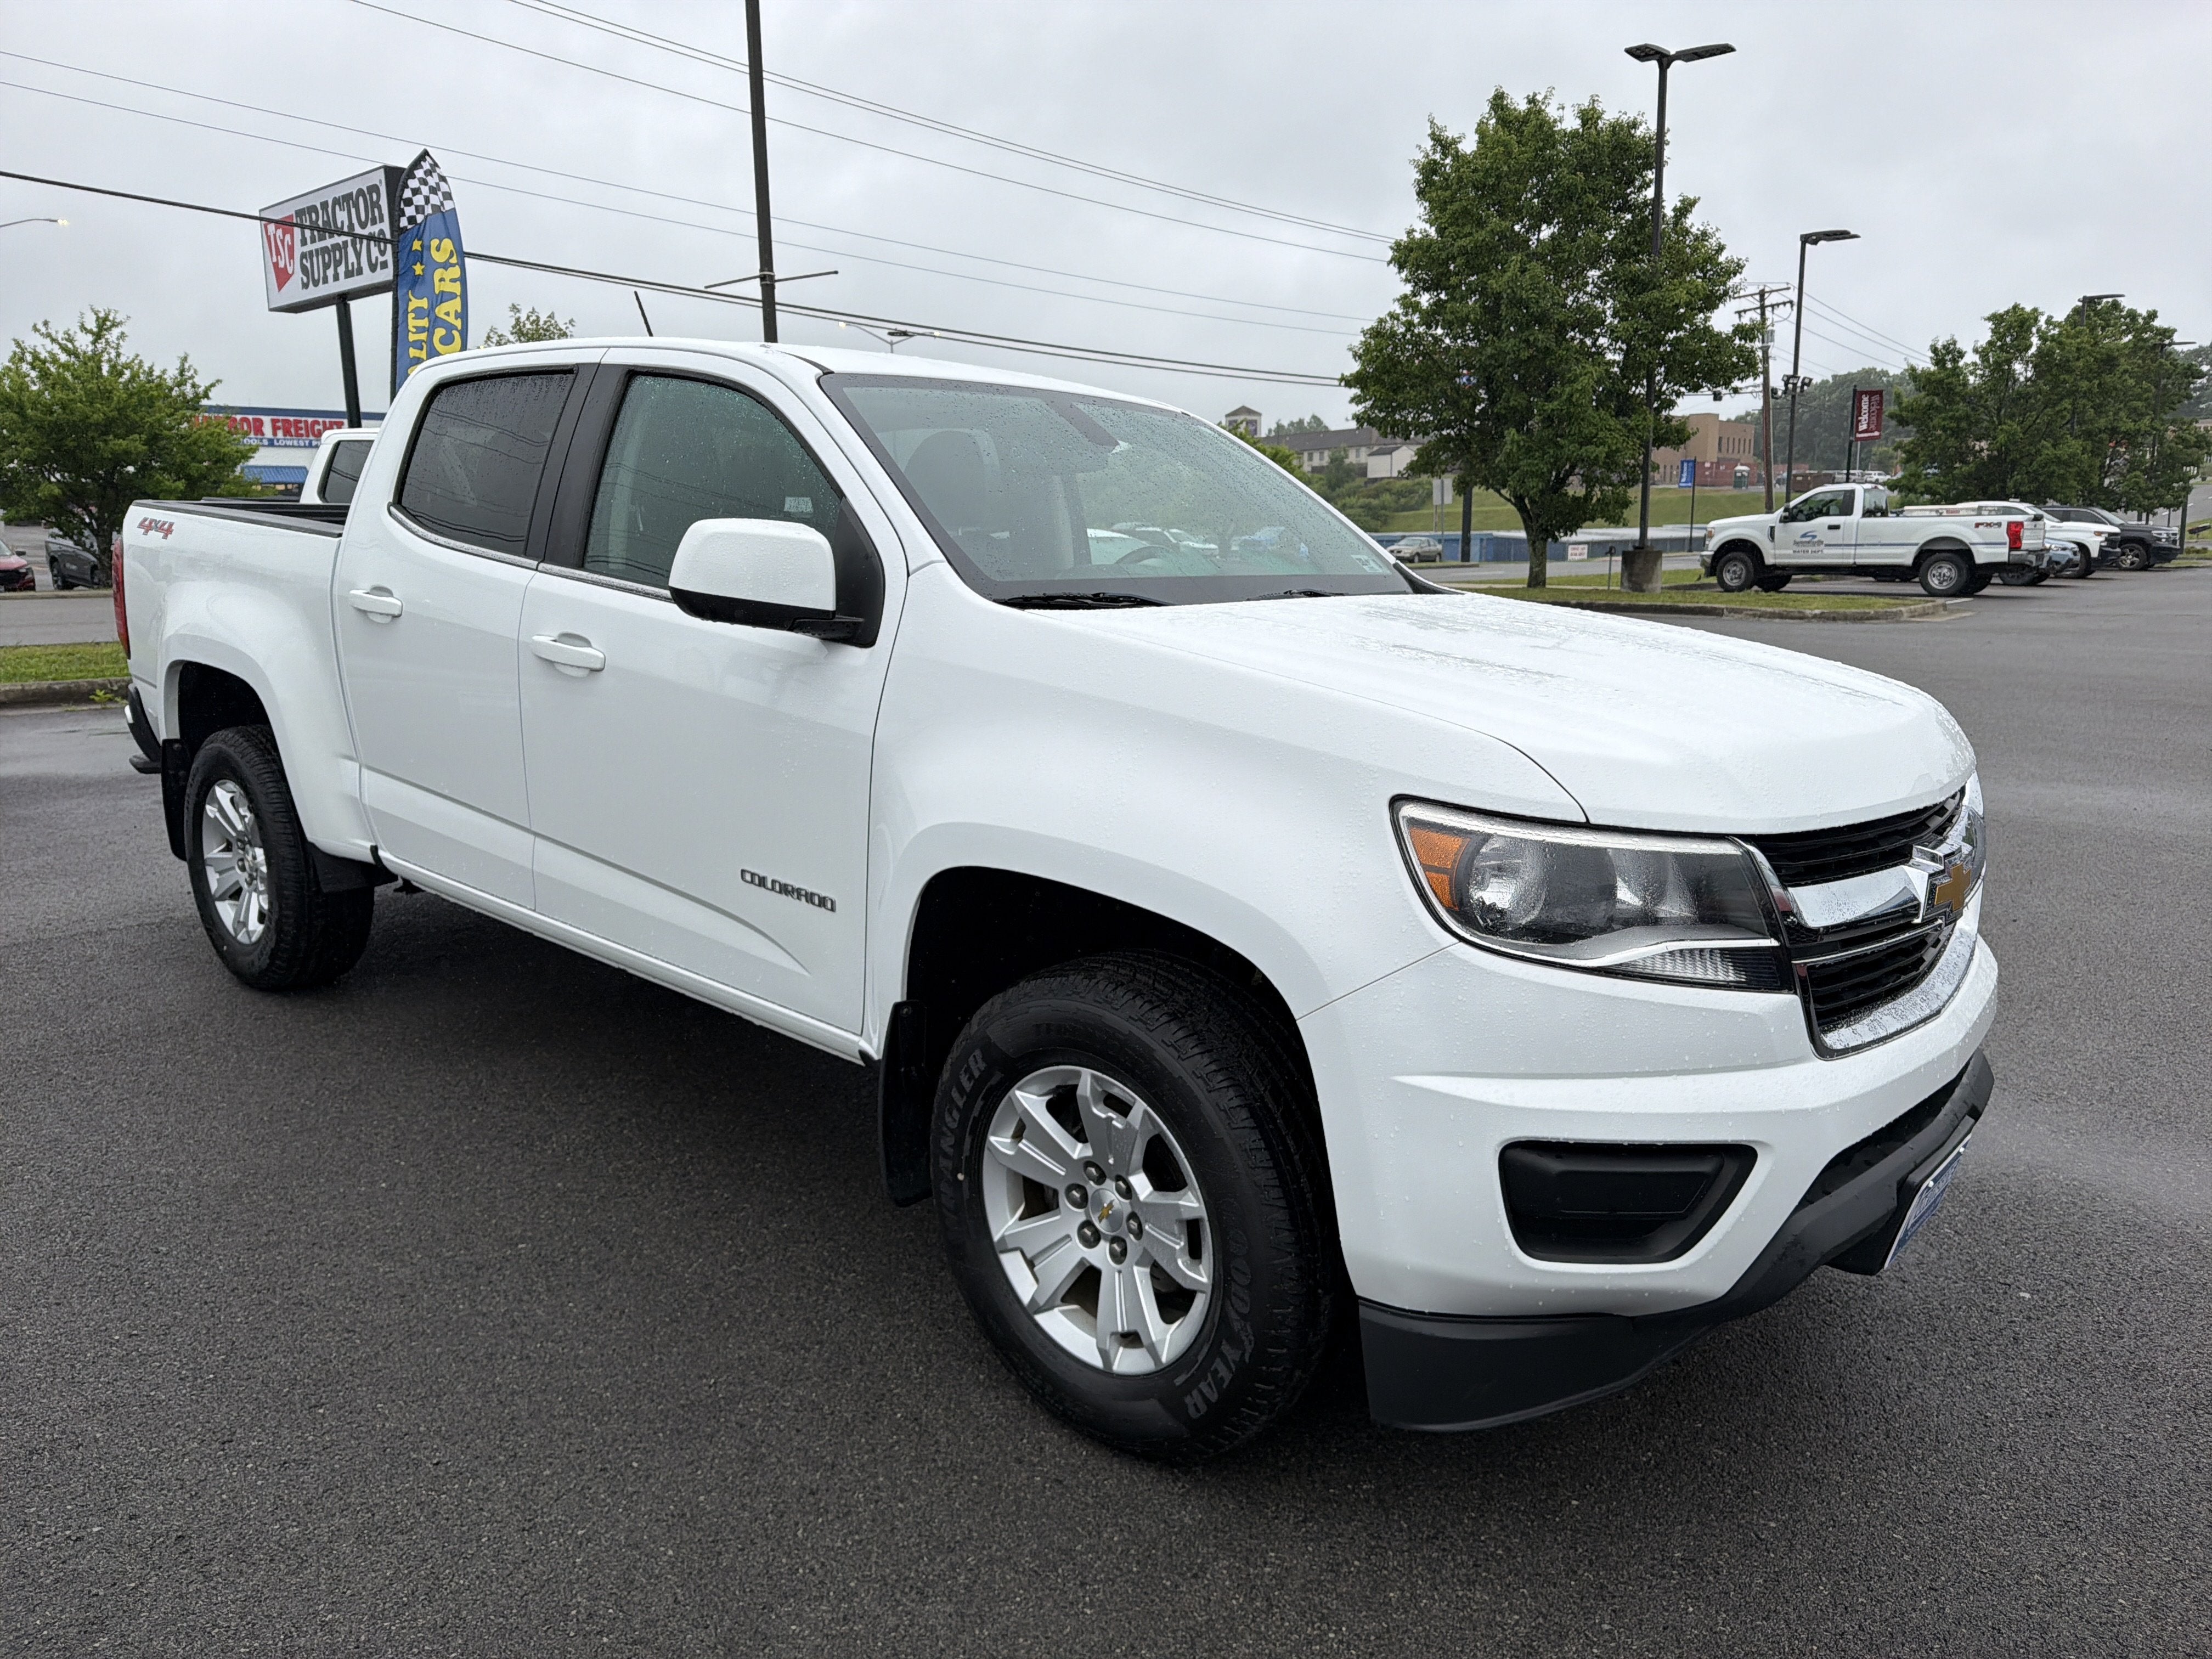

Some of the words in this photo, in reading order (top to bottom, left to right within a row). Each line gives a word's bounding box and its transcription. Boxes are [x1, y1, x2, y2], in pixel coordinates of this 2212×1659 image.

[295, 183, 384, 247] TRACTOR
[267, 223, 294, 274] TSC
[300, 238, 364, 290] SUPPLY
[431, 237, 462, 356] CARS
[407, 290, 430, 375] LITY
[270, 417, 345, 438] FREIGHT
[1858, 394, 1870, 432] Welcome
[741, 868, 836, 913] COLORADO
